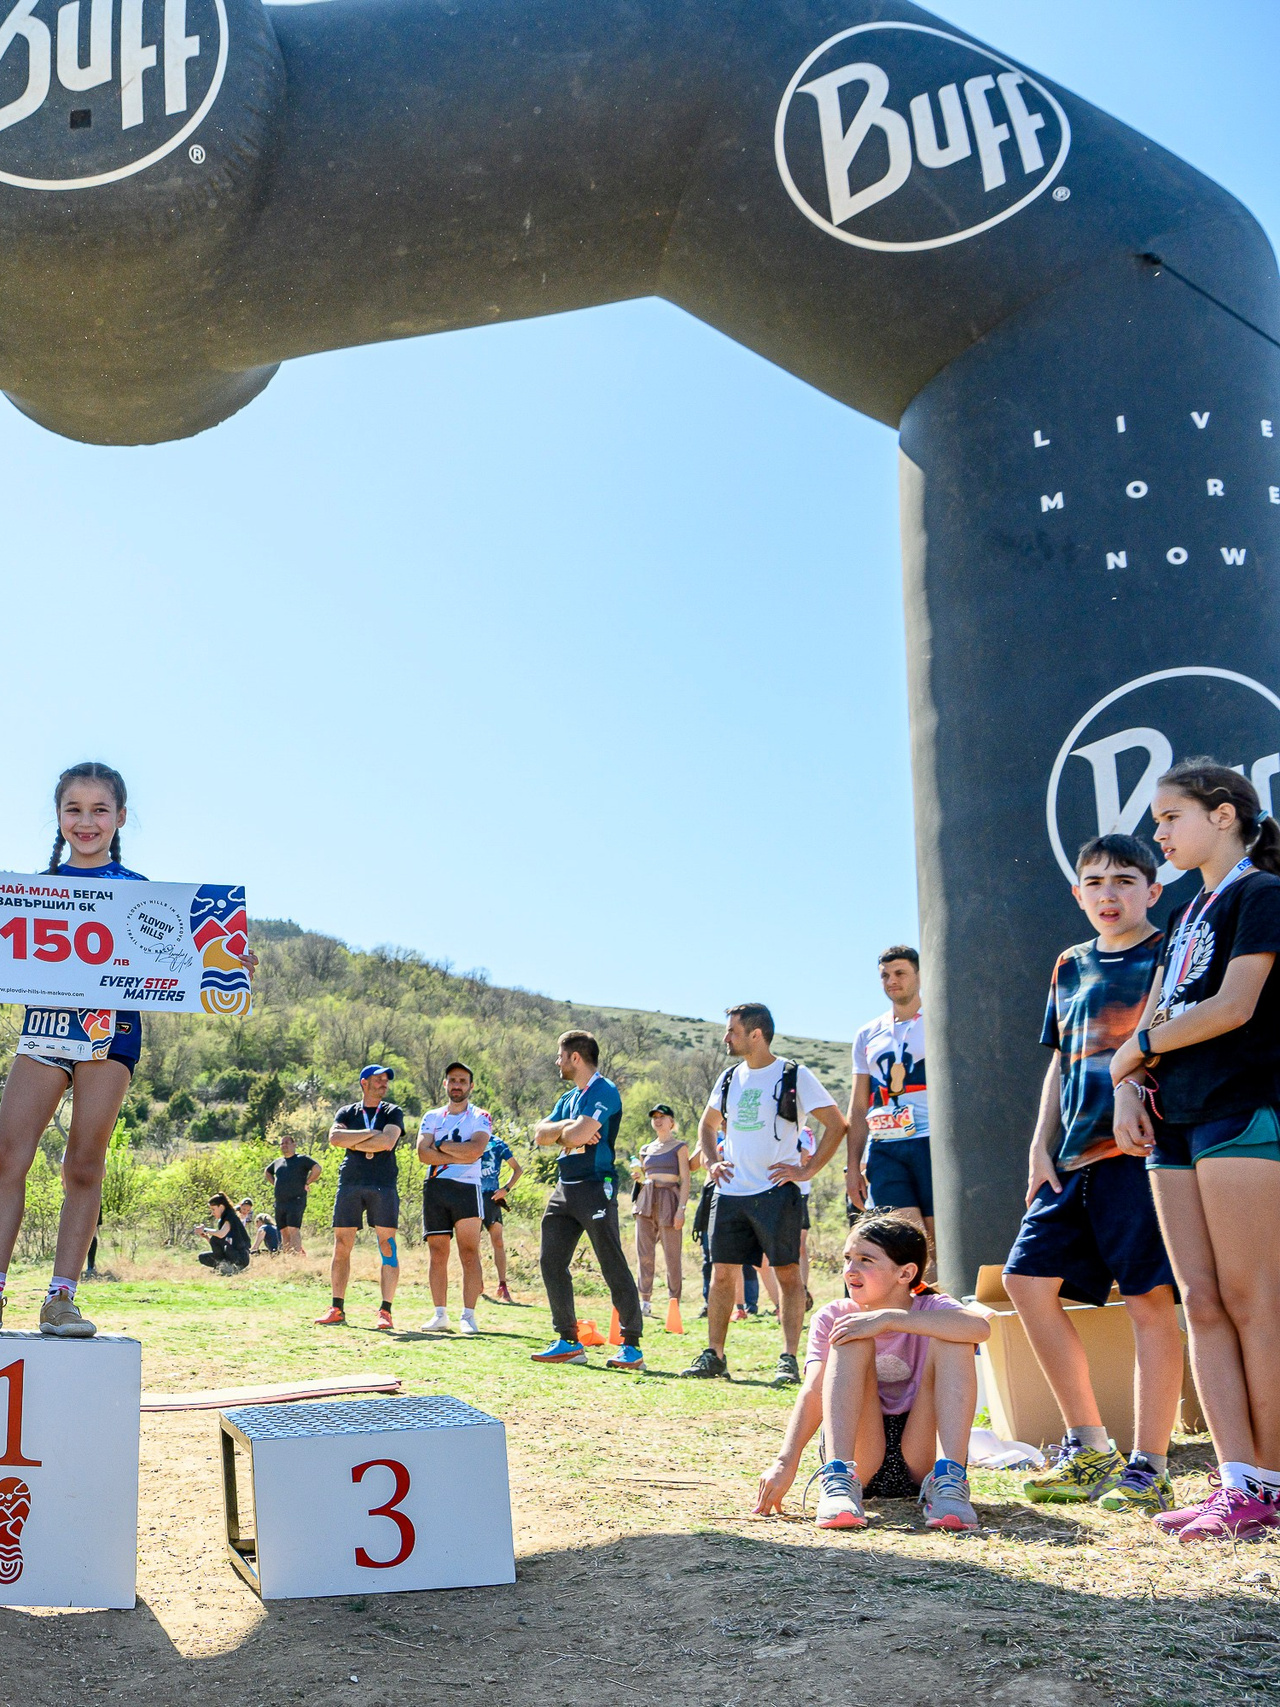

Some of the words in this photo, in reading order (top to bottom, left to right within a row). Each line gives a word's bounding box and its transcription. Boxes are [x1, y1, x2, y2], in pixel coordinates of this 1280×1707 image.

[1033, 411, 1274, 448] LIVE
[1040, 479, 1280, 513] MORE
[1106, 546, 1246, 570] NOW
[73, 889, 113, 900] БЕГАЧ
[138, 912, 175, 933] PLOVDIV
[140, 924, 164, 941] HILLS
[99, 975, 144, 988] EVERY
[144, 977, 179, 990] STEP
[123, 988, 185, 1001] MATTERS
[27, 1011, 70, 1037] 0118
[351, 1458, 416, 1569] 3
